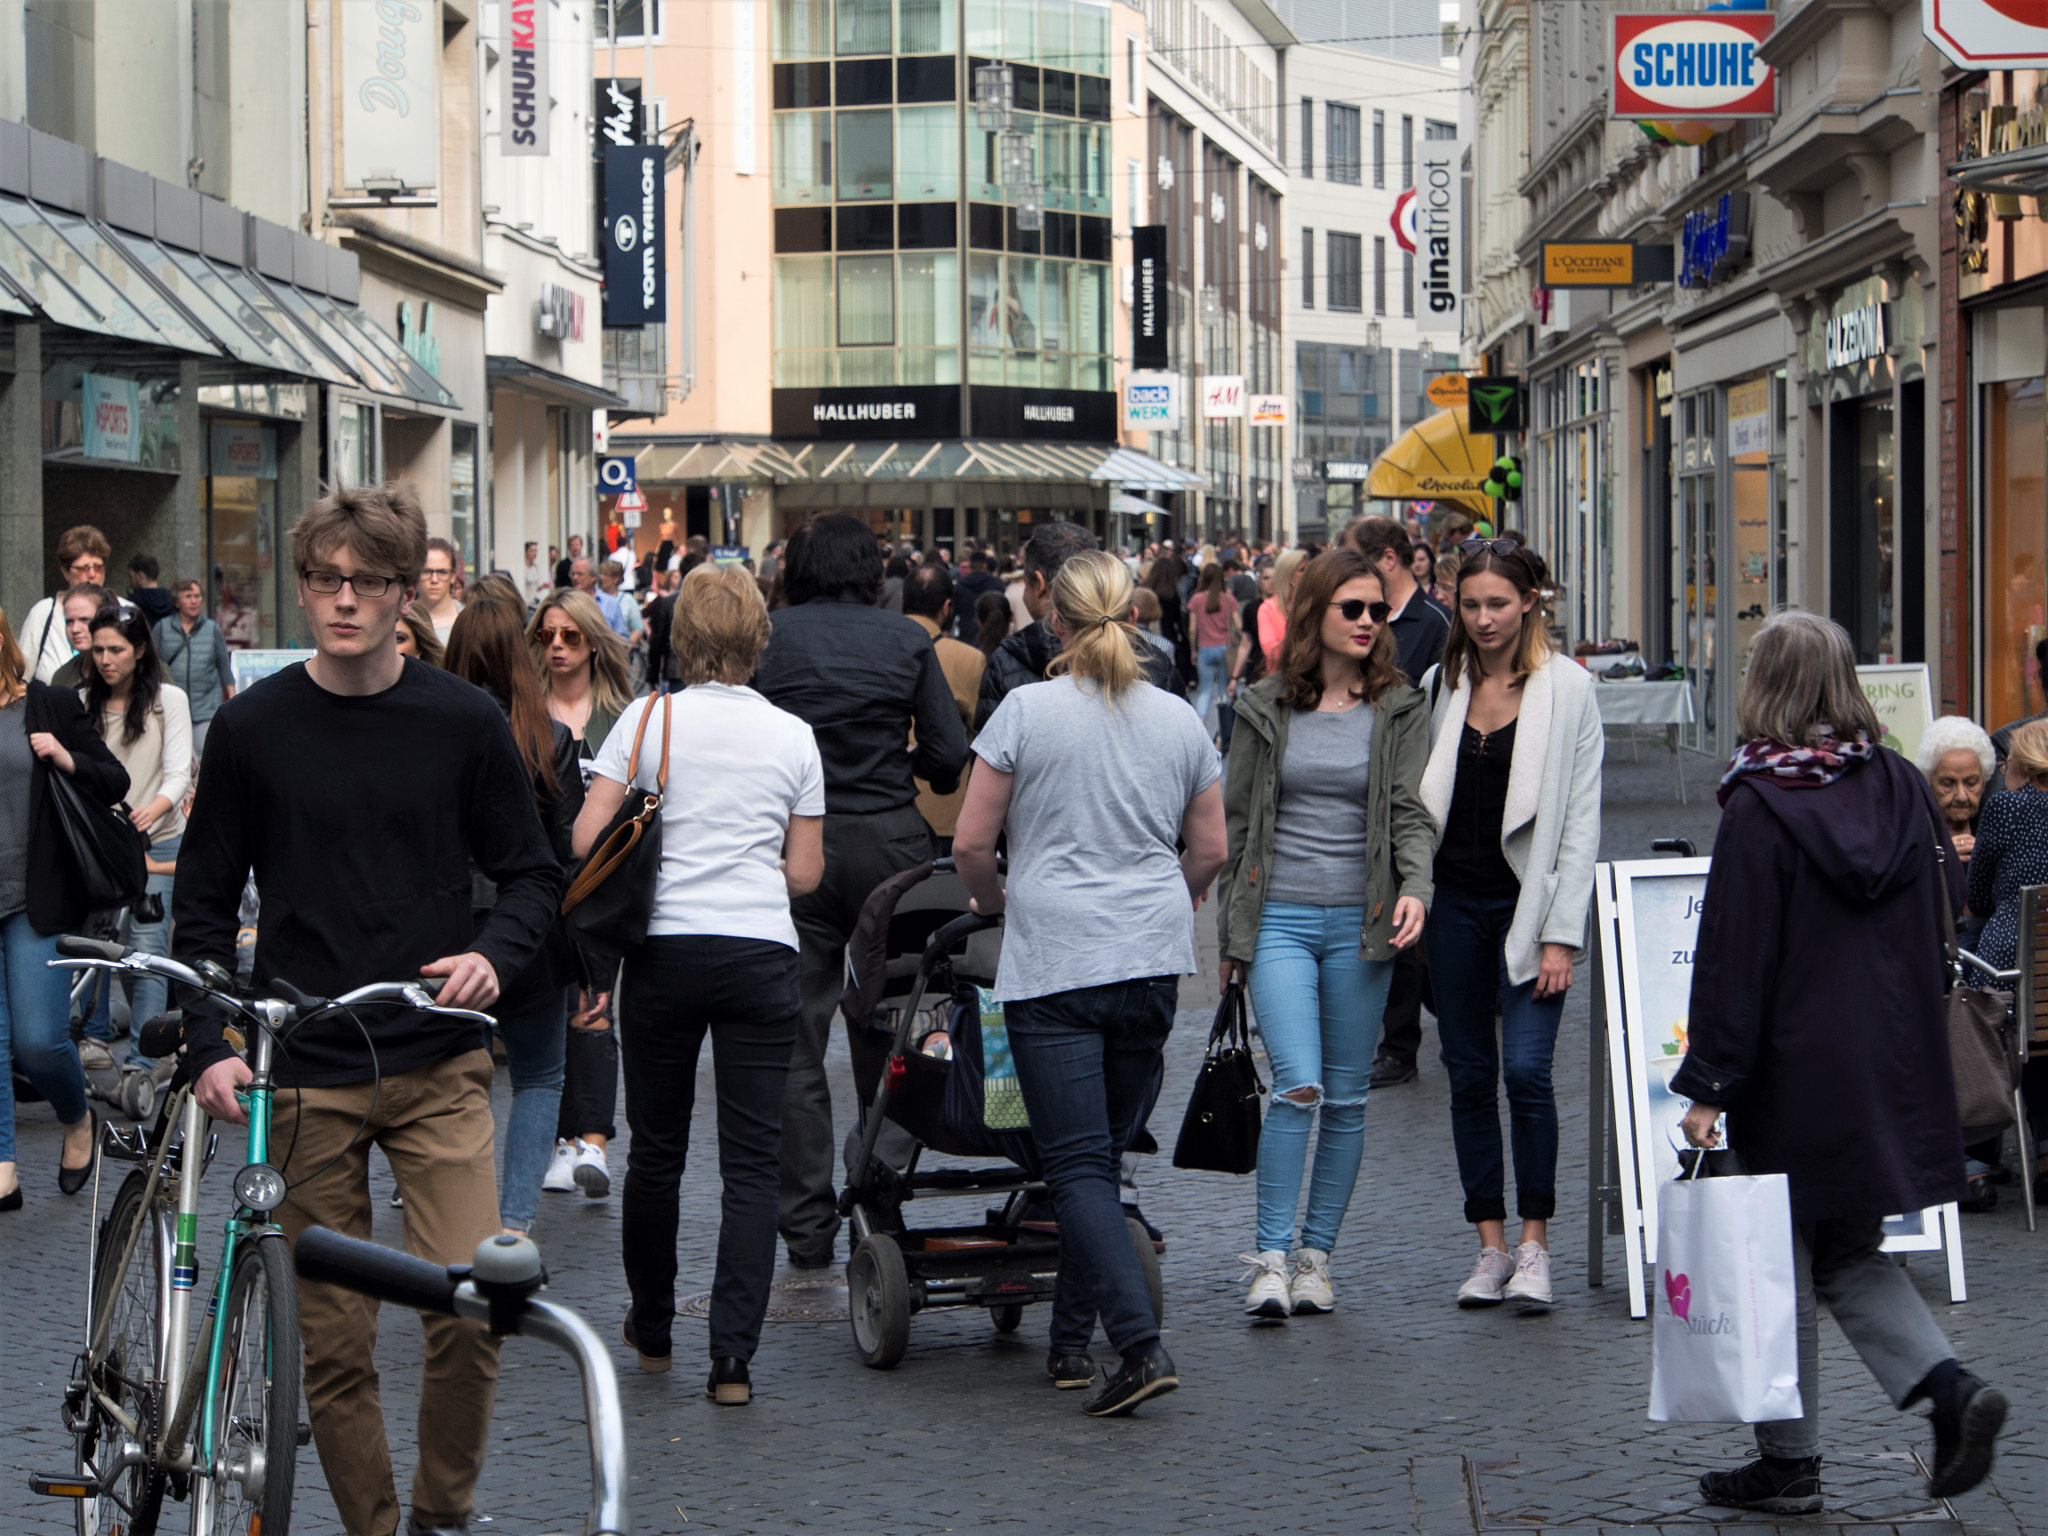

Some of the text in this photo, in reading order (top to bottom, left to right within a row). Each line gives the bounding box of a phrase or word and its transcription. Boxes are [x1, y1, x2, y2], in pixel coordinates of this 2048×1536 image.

[1633, 42, 1755, 87] SCHUHE
[641, 157, 656, 310] TOM TAILOR
[1422, 159, 1456, 313] ginatricot
[1552, 254, 1626, 268] L'OCCITANE
[1142, 257, 1155, 337] HALLHUBER
[1826, 302, 1885, 370] CALZEDONIA
[1130, 387, 1168, 402] back
[1258, 401, 1281, 413] dm
[100, 402, 128, 435] SPORTS
[814, 403, 916, 420] HALLHUBER
[1024, 404, 1075, 422] HALLHUBER
[1129, 406, 1169, 419] WERK
